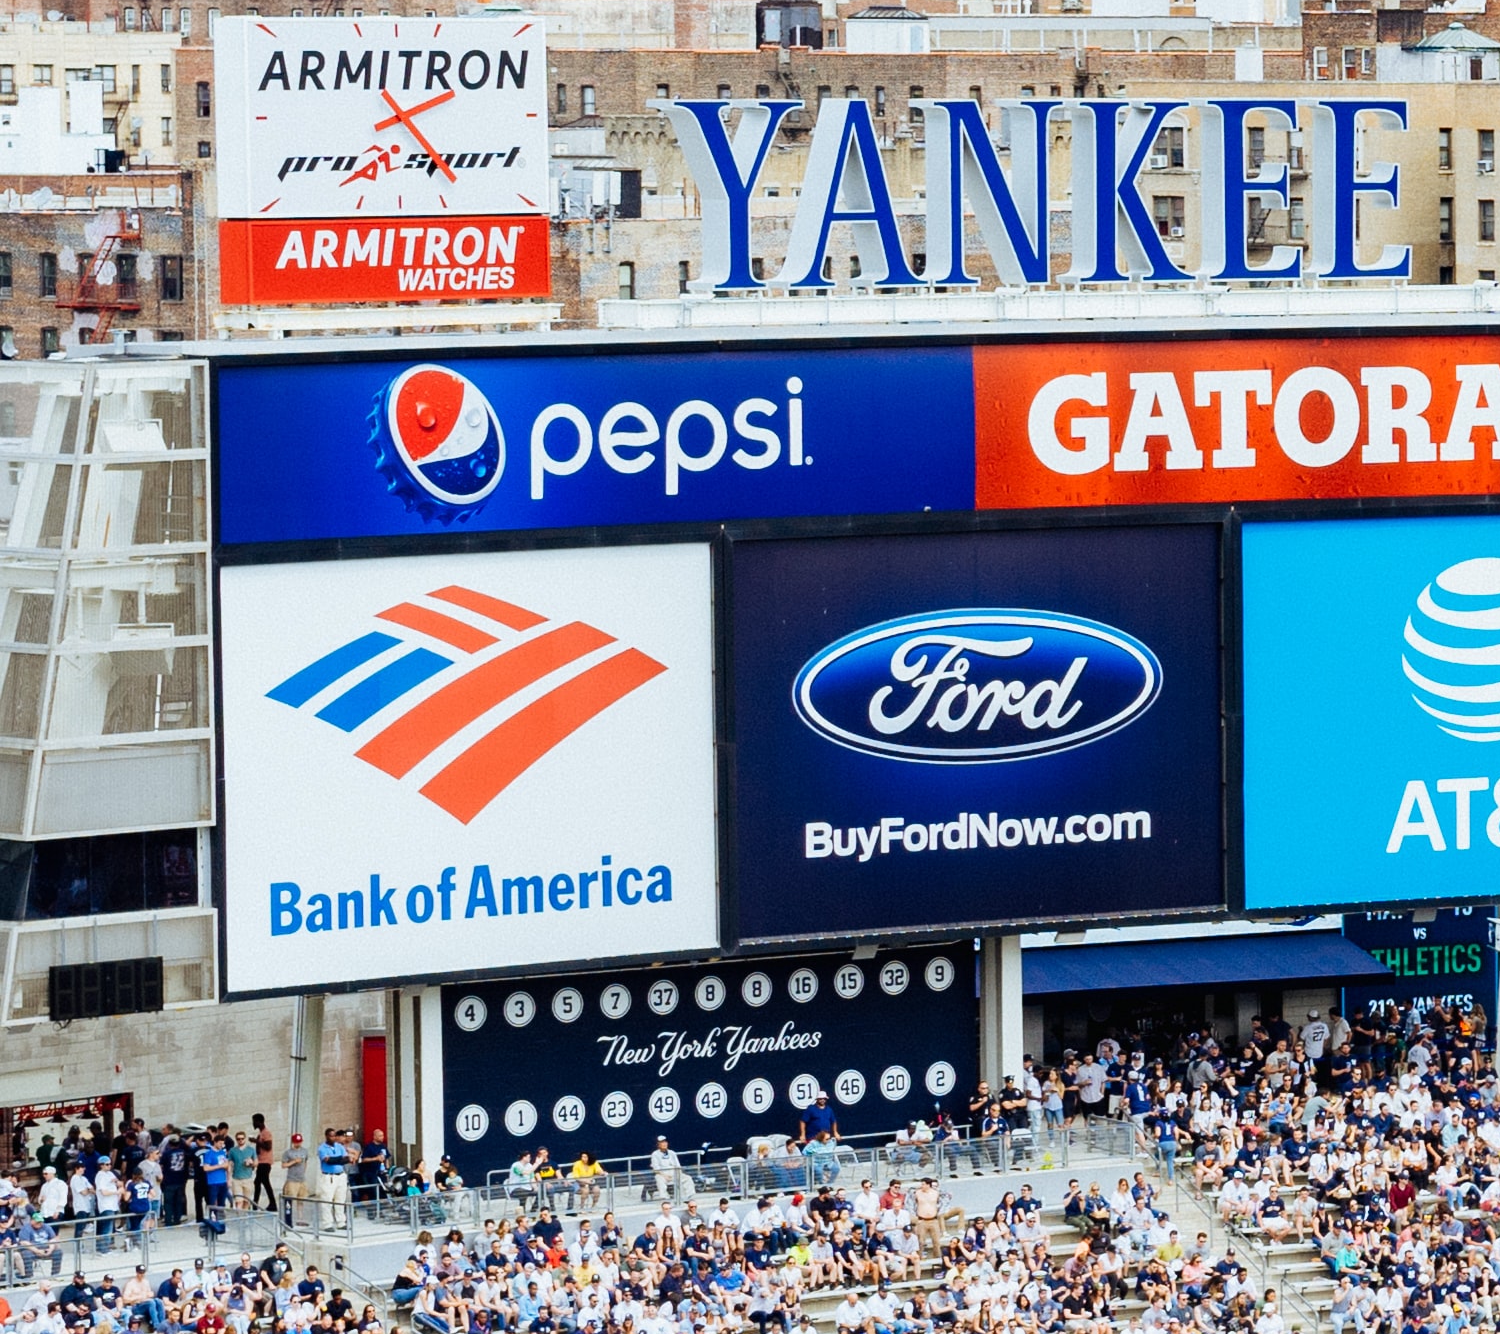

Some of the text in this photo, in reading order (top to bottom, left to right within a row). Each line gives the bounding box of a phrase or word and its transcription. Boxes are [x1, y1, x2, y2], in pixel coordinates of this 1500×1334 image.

[259, 50, 528, 99] ARMITRON
[648, 95, 1411, 291] YANKEE
[276, 226, 523, 269] ARMITRON
[399, 266, 514, 291] WATCHES
[531, 377, 803, 499] pepsi
[869, 635, 1101, 748] Ford
[806, 811, 1151, 862] BuyFordNow.com
[270, 855, 672, 936] Bank of America
[596, 1020, 821, 1076] New York Yankees
